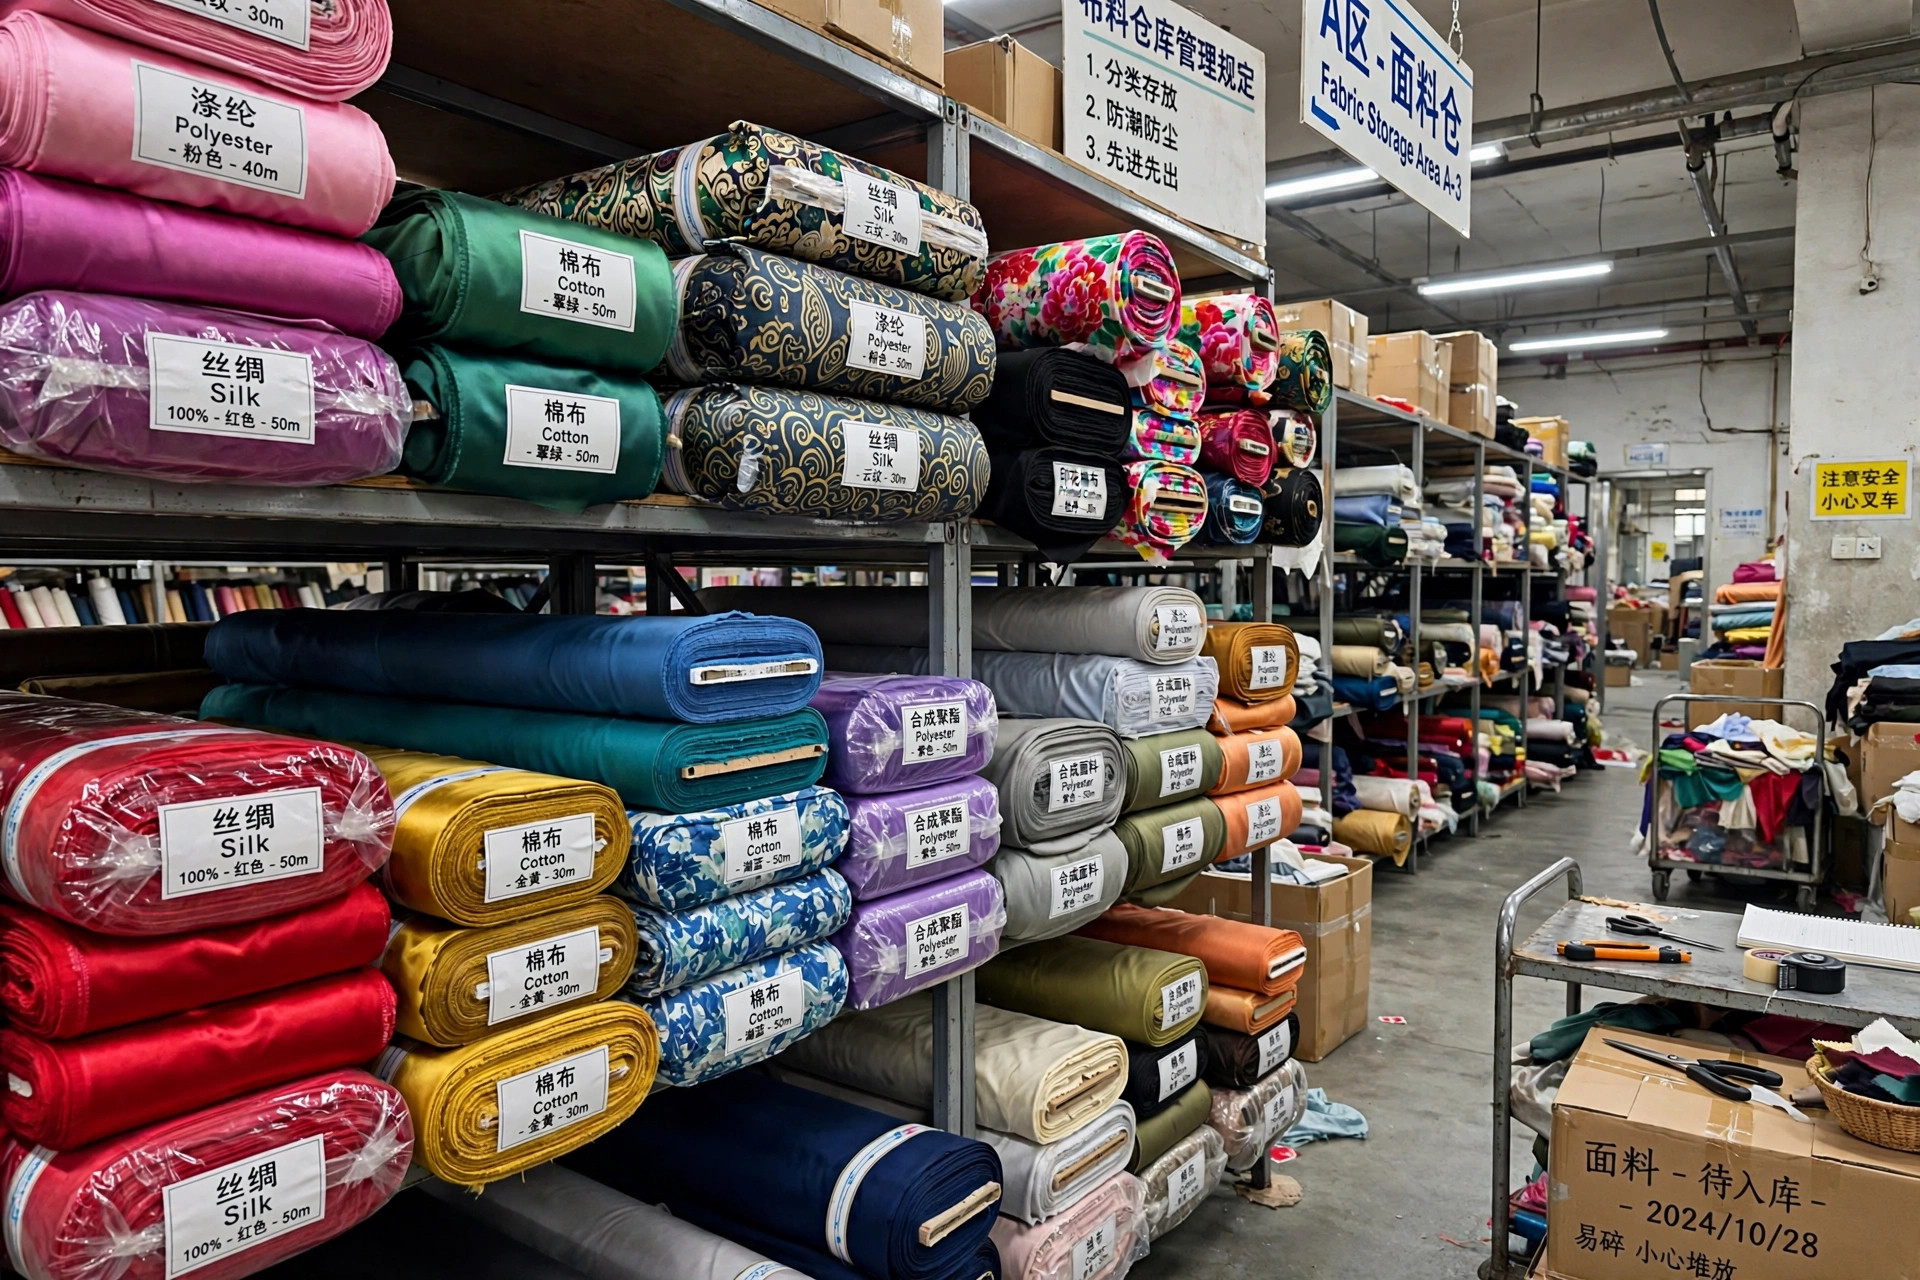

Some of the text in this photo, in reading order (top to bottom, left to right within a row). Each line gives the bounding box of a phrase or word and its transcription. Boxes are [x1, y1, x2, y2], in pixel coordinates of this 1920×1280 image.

[248, 5, 284, 30] 30m
[1086, 53, 1178, 112] 1. 分类存放
[191, 86, 257, 128] 涤纶
[1086, 94, 1179, 152] 2. 防潮防尘
[1321, 60, 1462, 202] Fabric Storage Area A-3
[175, 116, 273, 156] Polyester
[182, 142, 223, 170] 粉色
[242, 160, 278, 181] 40m
[1086, 135, 1178, 191] 3. 先进先出
[874, 206, 894, 224] Silk
[892, 230, 908, 245] 30m
[559, 248, 601, 278] 棉布
[558, 276, 605, 298] Cotton
[592, 303, 616, 319] 50m
[202, 350, 265, 385] 丝绸
[210, 382, 261, 407] Silk
[168, 406, 209, 423] 100%
[225, 410, 256, 429] 红色
[271, 417, 300, 431] 50m
[544, 399, 586, 426] 棉布
[542, 426, 589, 444] Cotton
[576, 450, 599, 463] 50m
[872, 452, 893, 468] Silk
[1822, 468, 1900, 487] 注意安全
[1821, 490, 1899, 510] 小心叉车
[915, 729, 956, 742] Polyester
[943, 742, 958, 753] 50m
[213, 803, 274, 836] 丝绸
[747, 818, 777, 841] 棉布
[221, 834, 270, 858] Silk
[522, 827, 562, 854] 棉布
[747, 841, 781, 856] Cotton
[919, 829, 958, 845] Polyester
[179, 868, 219, 885] 100%
[234, 859, 265, 877] 红色
[280, 855, 308, 869] 50m
[520, 853, 565, 871] Cotton
[773, 854, 791, 865] 50m
[515, 871, 541, 889] 金黄
[552, 867, 575, 880] 30m
[919, 935, 957, 954] Polyester
[526, 944, 566, 972] 棉布
[524, 970, 569, 991] Cotton
[557, 983, 580, 997] 30m
[750, 983, 780, 1009] 棉布
[749, 1005, 783, 1025] Cotton
[774, 1017, 792, 1030] 50m
[535, 1066, 575, 1097] 棉布
[533, 1091, 578, 1115] Cotton
[566, 1103, 589, 1119] 30m
[216, 1160, 278, 1205] 丝绸
[1584, 1141, 1660, 1187] 面料
[1698, 1162, 1801, 1214] 待入库
[224, 1195, 273, 1226] Silk
[184, 1237, 222, 1262] 100%
[237, 1220, 267, 1242] 红色
[282, 1206, 310, 1224] 50m
[1646, 1200, 1818, 1258] 2024/10/28
[1574, 1223, 1737, 1280] 易碎 小心堆放
